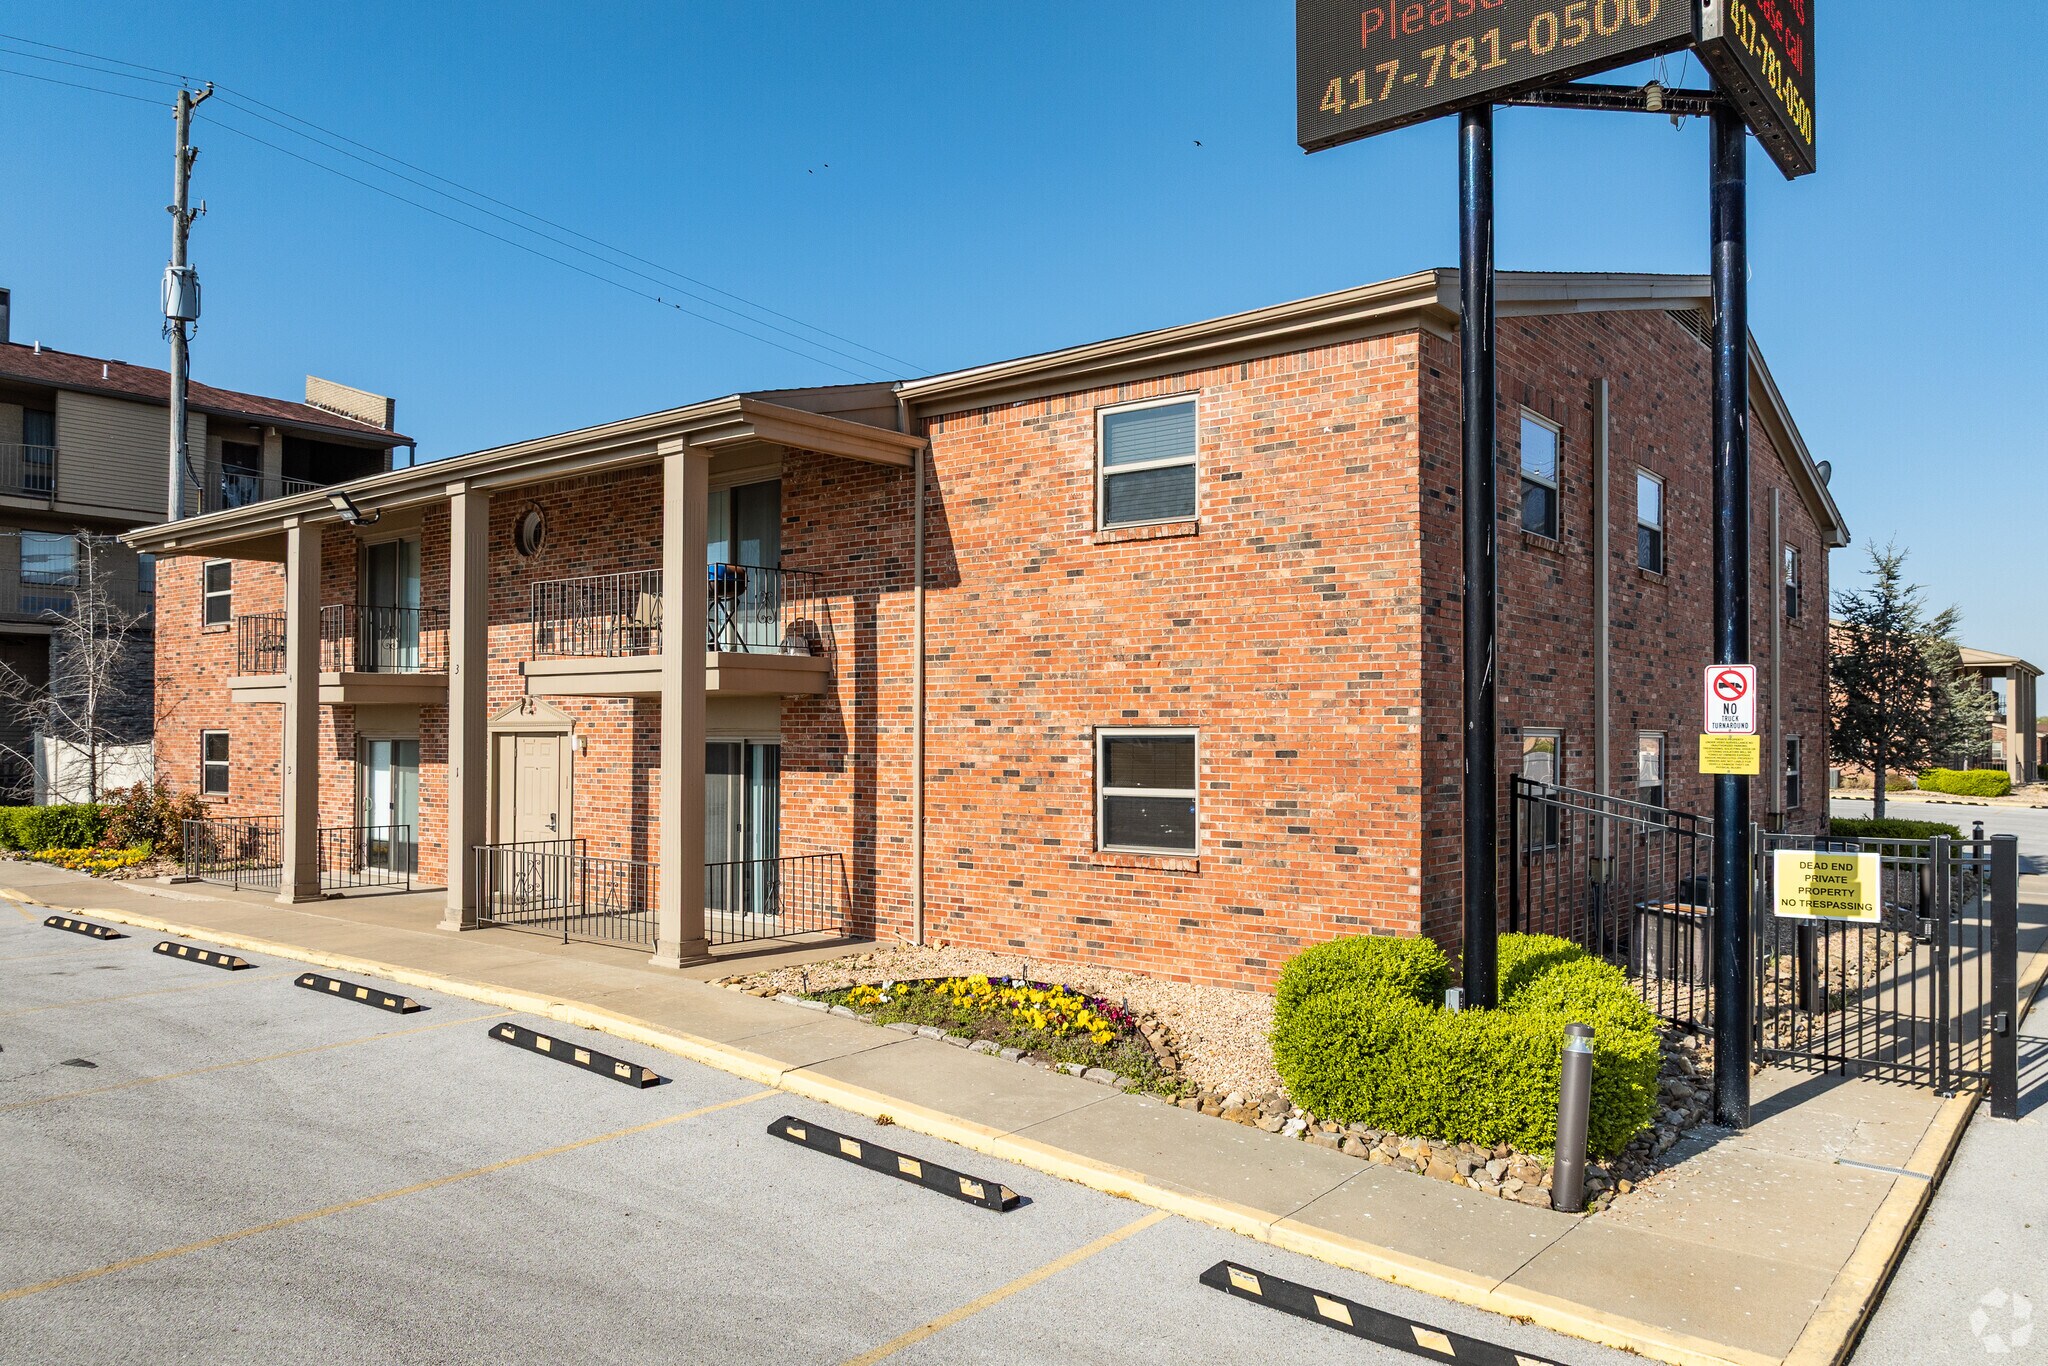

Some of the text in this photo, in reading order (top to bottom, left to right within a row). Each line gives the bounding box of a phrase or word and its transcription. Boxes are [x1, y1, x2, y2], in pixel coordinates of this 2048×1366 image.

[1319, 0, 1660, 115] 417-781-0500
[1785, 27, 1803, 77] call
[1730, 0, 1812, 145] 417-781-0500
[455, 664, 460, 674] 3
[1723, 703, 1737, 715] NO
[1799, 861, 1853, 871] DEAD END
[1804, 874, 1848, 884] PRIVATE
[1798, 887, 1855, 897] PROPERTY
[1781, 898, 1873, 911] NO TRESPASSING
